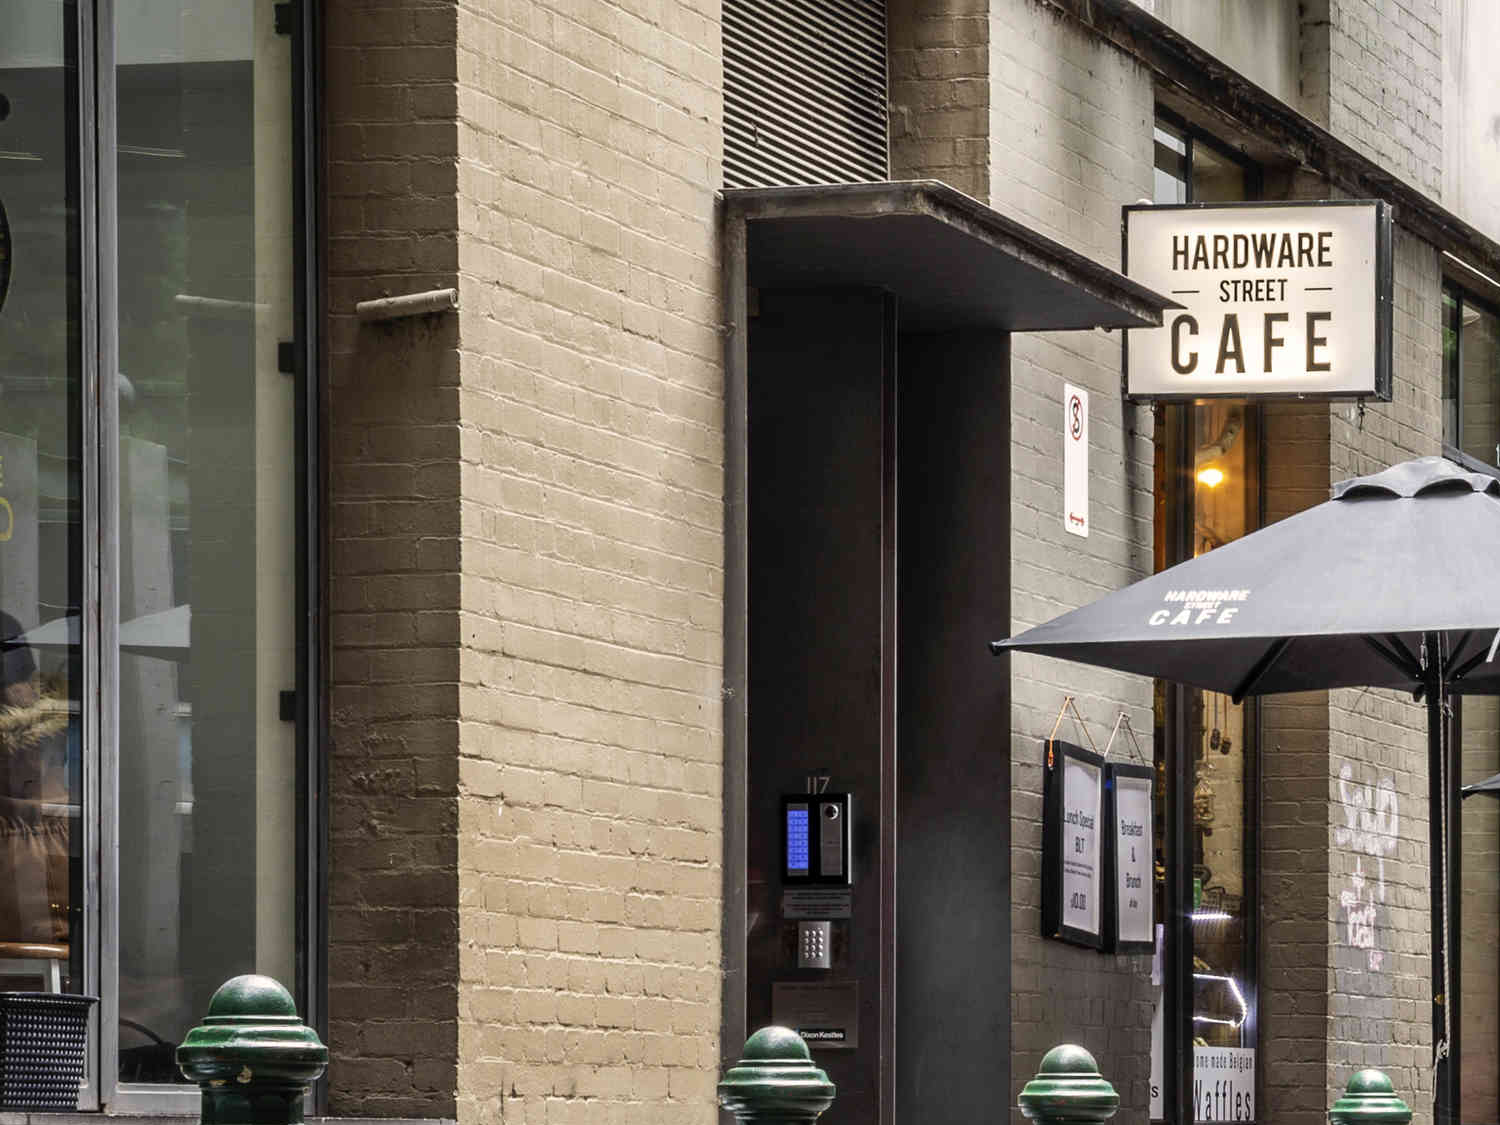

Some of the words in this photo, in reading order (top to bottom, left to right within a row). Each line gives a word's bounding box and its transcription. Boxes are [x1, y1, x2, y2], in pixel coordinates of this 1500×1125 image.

[1172, 231, 1333, 270] HARDWARE
[1219, 278, 1288, 302] STREET
[1171, 311, 1331, 375] CAFE
[1164, 590, 1250, 601] HARDWARE
[1149, 609, 1238, 625] CAFE
[1193, 1055, 1208, 1068] ome
[1211, 1053, 1226, 1069] made
[1229, 1052, 1253, 1072] Belgian
